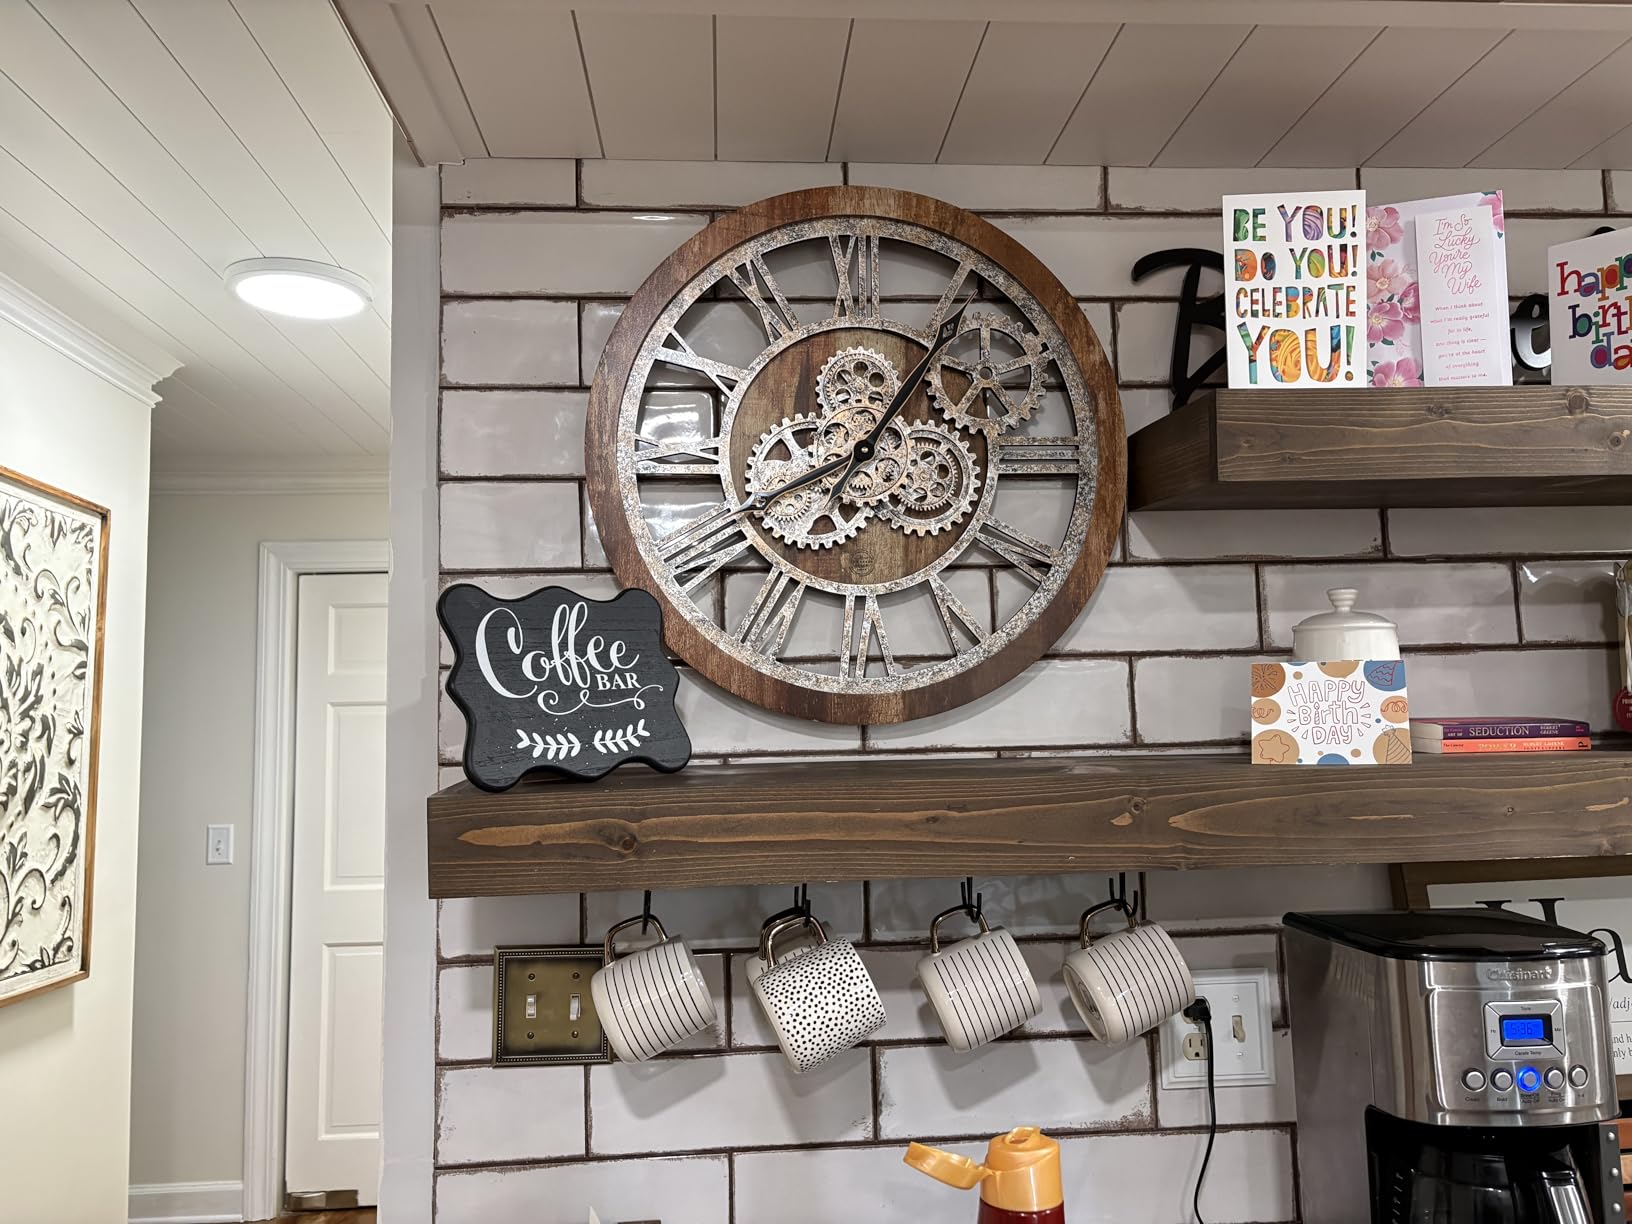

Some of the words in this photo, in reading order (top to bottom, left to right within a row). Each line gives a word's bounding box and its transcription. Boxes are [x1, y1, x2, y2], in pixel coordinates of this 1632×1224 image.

[1233, 208, 1267, 241] BE
[1277, 204, 1357, 242] YOU!
[1433, 218, 1454, 237] I'm
[1434, 226, 1481, 251] Lucky
[1288, 243, 1359, 280] YOU!
[1429, 249, 1471, 274] You're
[1442, 261, 1473, 280] My
[1447, 275, 1482, 294] Wife
[1556, 253, 1632, 301] happ
[1235, 283, 1356, 319] CELEBRATE
[1237, 321, 1355, 384] YOU!
[1590, 331, 1632, 371] da
[476, 602, 640, 698] Coffee
[595, 672, 641, 691] BAR
[1287, 680, 1366, 707] HAPPY
[1298, 700, 1359, 726] Birth
[1312, 725, 1353, 745] DAY
[1469, 726, 1529, 736] SEDUCTION
[1612, 1033, 1625, 1044] nd
[1613, 1047, 1626, 1060] nly
